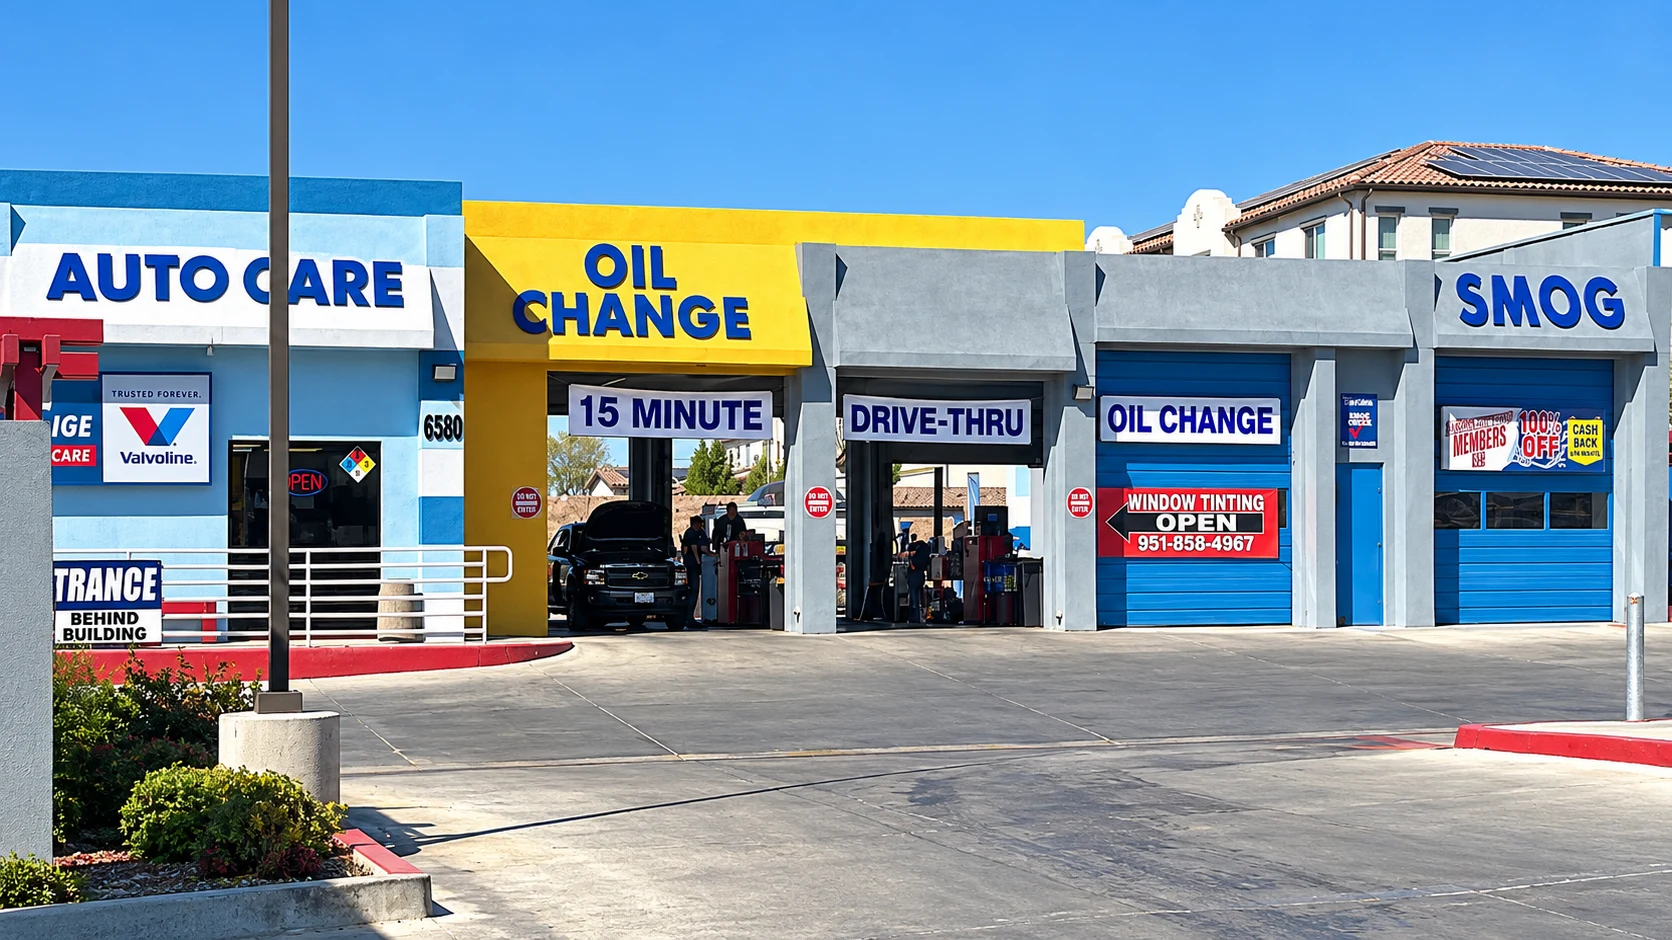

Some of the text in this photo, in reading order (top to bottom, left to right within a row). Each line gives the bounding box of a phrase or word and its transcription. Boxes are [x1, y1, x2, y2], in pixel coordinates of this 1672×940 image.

[584, 243, 677, 290] OIL
[46, 253, 404, 308] AUTO CARE
[1456, 272, 1626, 330] SMOG
[512, 290, 752, 340] CHANGE
[112, 390, 202, 399] TRUSTED FOREVER.
[580, 395, 763, 430] 15 MINUTE
[851, 404, 1024, 437] DRIVE-THRU
[1107, 404, 1273, 435] OIL CHANGE
[1519, 410, 1562, 434] 100%
[52, 414, 93, 438] IGE
[424, 414, 463, 441] 6580
[1573, 424, 1598, 435] CASH
[1453, 425, 1507, 457] MEMBERS
[1523, 436, 1559, 457] OFF
[1574, 438, 1597, 448] BACK
[51, 449, 90, 462] CARE
[288, 473, 322, 491] PEN
[1128, 494, 1264, 511] WINDOW TINTING
[1156, 514, 1237, 532] OPEN
[1138, 535, 1254, 551] 951-858-4967
[54, 567, 157, 602] TRANCE
[71, 612, 139, 626] BEHIND
[63, 627, 147, 641] BUILDING
